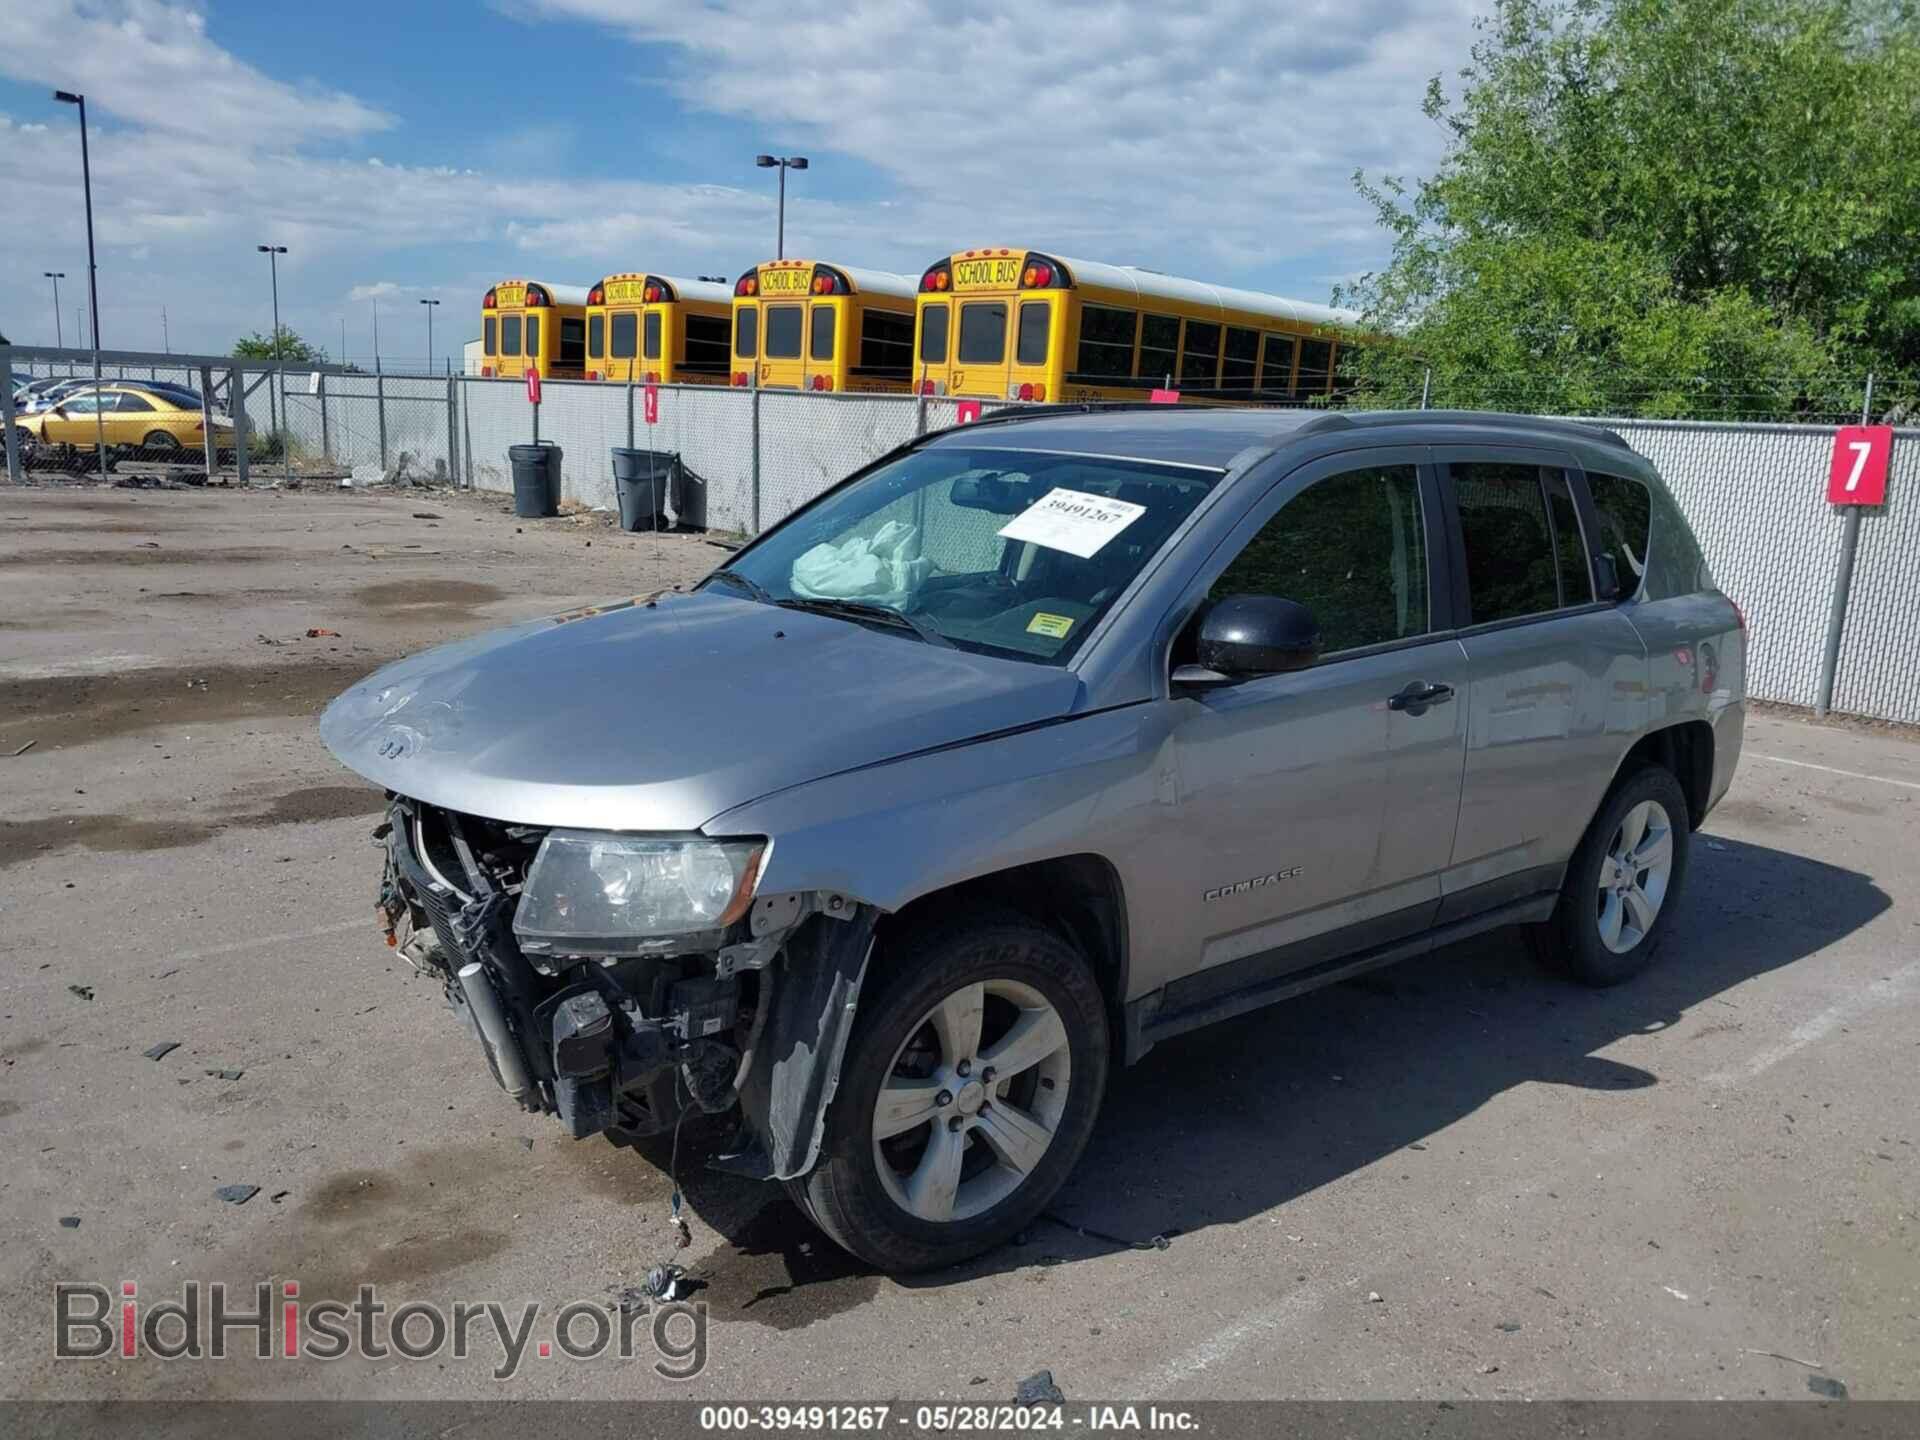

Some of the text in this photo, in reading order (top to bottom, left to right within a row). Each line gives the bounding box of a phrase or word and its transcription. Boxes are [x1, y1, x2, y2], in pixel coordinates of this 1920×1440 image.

[763, 270, 809, 290] SCHOOL BUS
[958, 261, 1017, 284] SCHOOL BUS
[1844, 441, 1872, 492] 7
[1203, 866, 1304, 903] COMPASS
